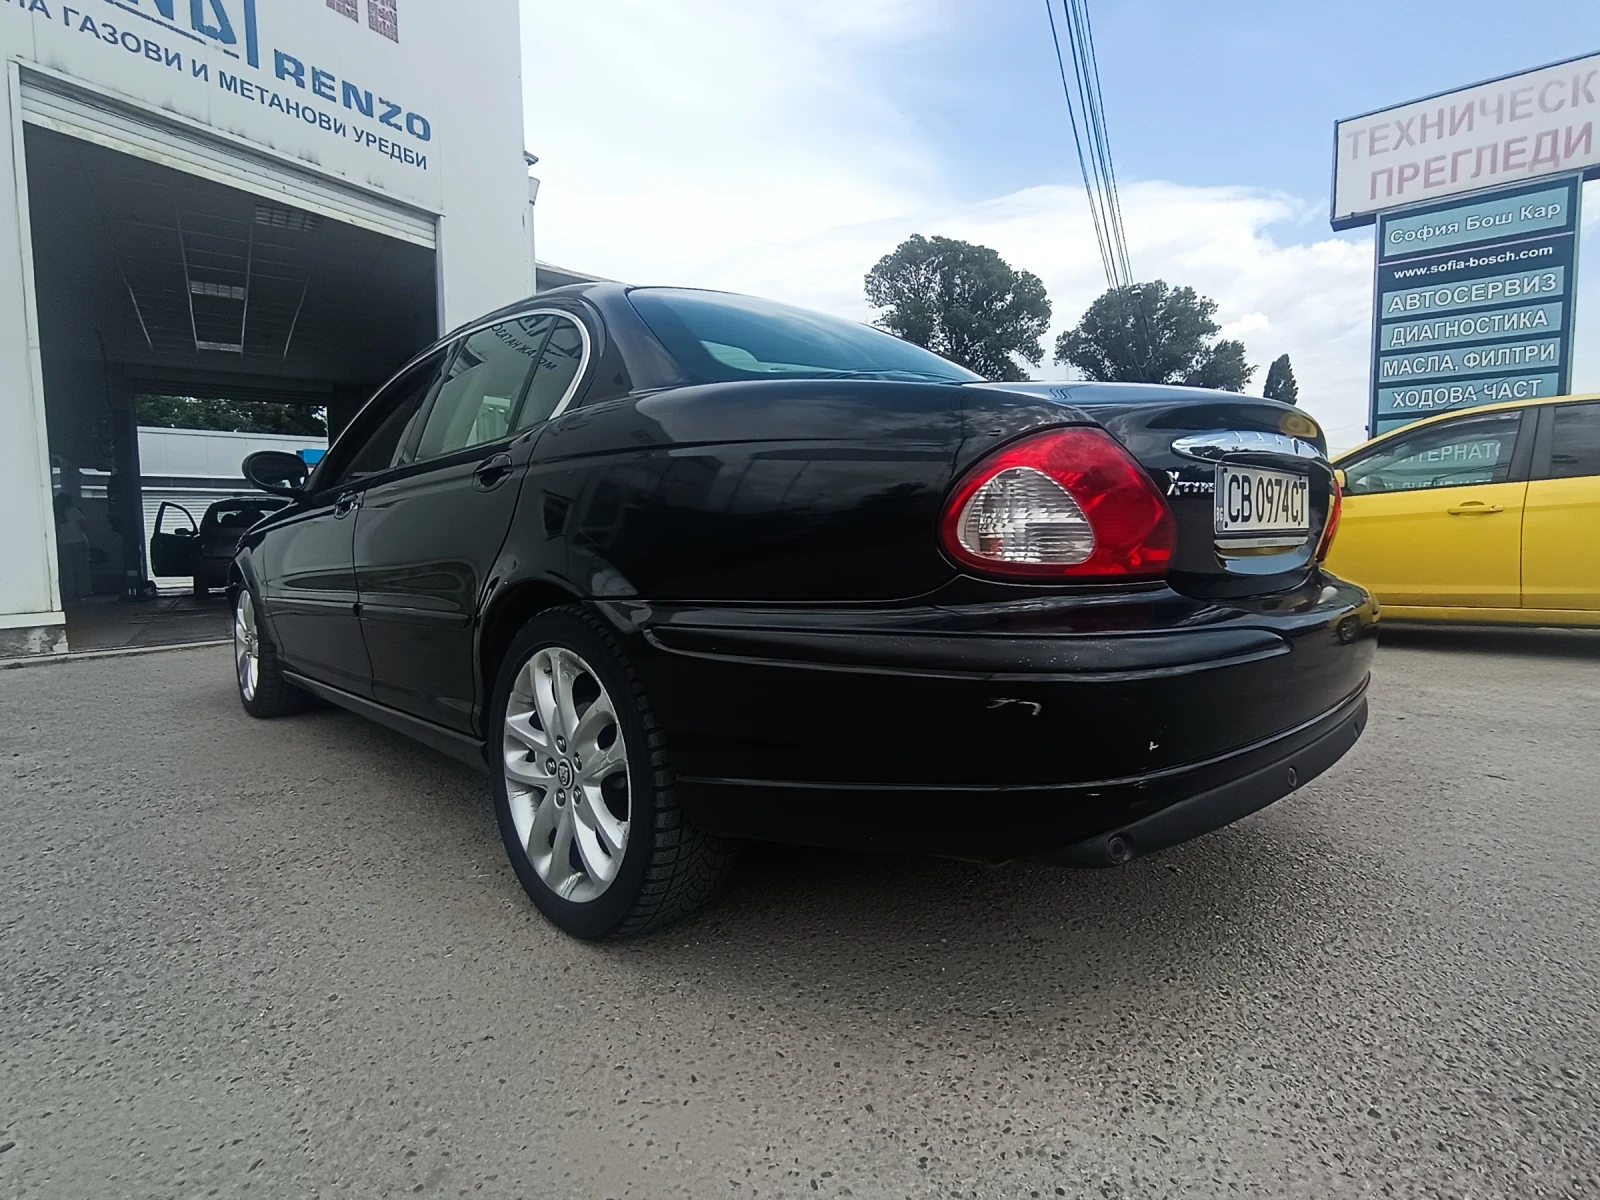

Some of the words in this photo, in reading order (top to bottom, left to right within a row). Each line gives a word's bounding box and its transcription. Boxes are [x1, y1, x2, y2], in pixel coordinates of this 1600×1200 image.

[62, 5, 182, 72] ГАЗОВИ
[191, 58, 209, 83] И
[218, 69, 347, 138] МЕТАНОВИ
[352, 125, 428, 171] УРЕДБИ
[273, 48, 432, 142] RENZO
[1345, 68, 1597, 161] ТЕХНИЧЕСК
[1369, 120, 1594, 201] ПРЕГЛЕДИ
[1389, 221, 1460, 244] София
[1465, 211, 1513, 231] Бош
[1519, 203, 1562, 222] Кар
[1393, 246, 1554, 280] www.sofia-bosch.com
[1387, 272, 1558, 314] АВТОСЕРВИЗ
[1389, 308, 1549, 348] ДИАГНОСТИКА
[1382, 354, 1460, 378] МАСЛА,
[1462, 342, 1556, 369] ФИЛТРИ
[1391, 384, 1478, 410] ХОДОВА
[1482, 378, 1544, 400] ЧАСТ
